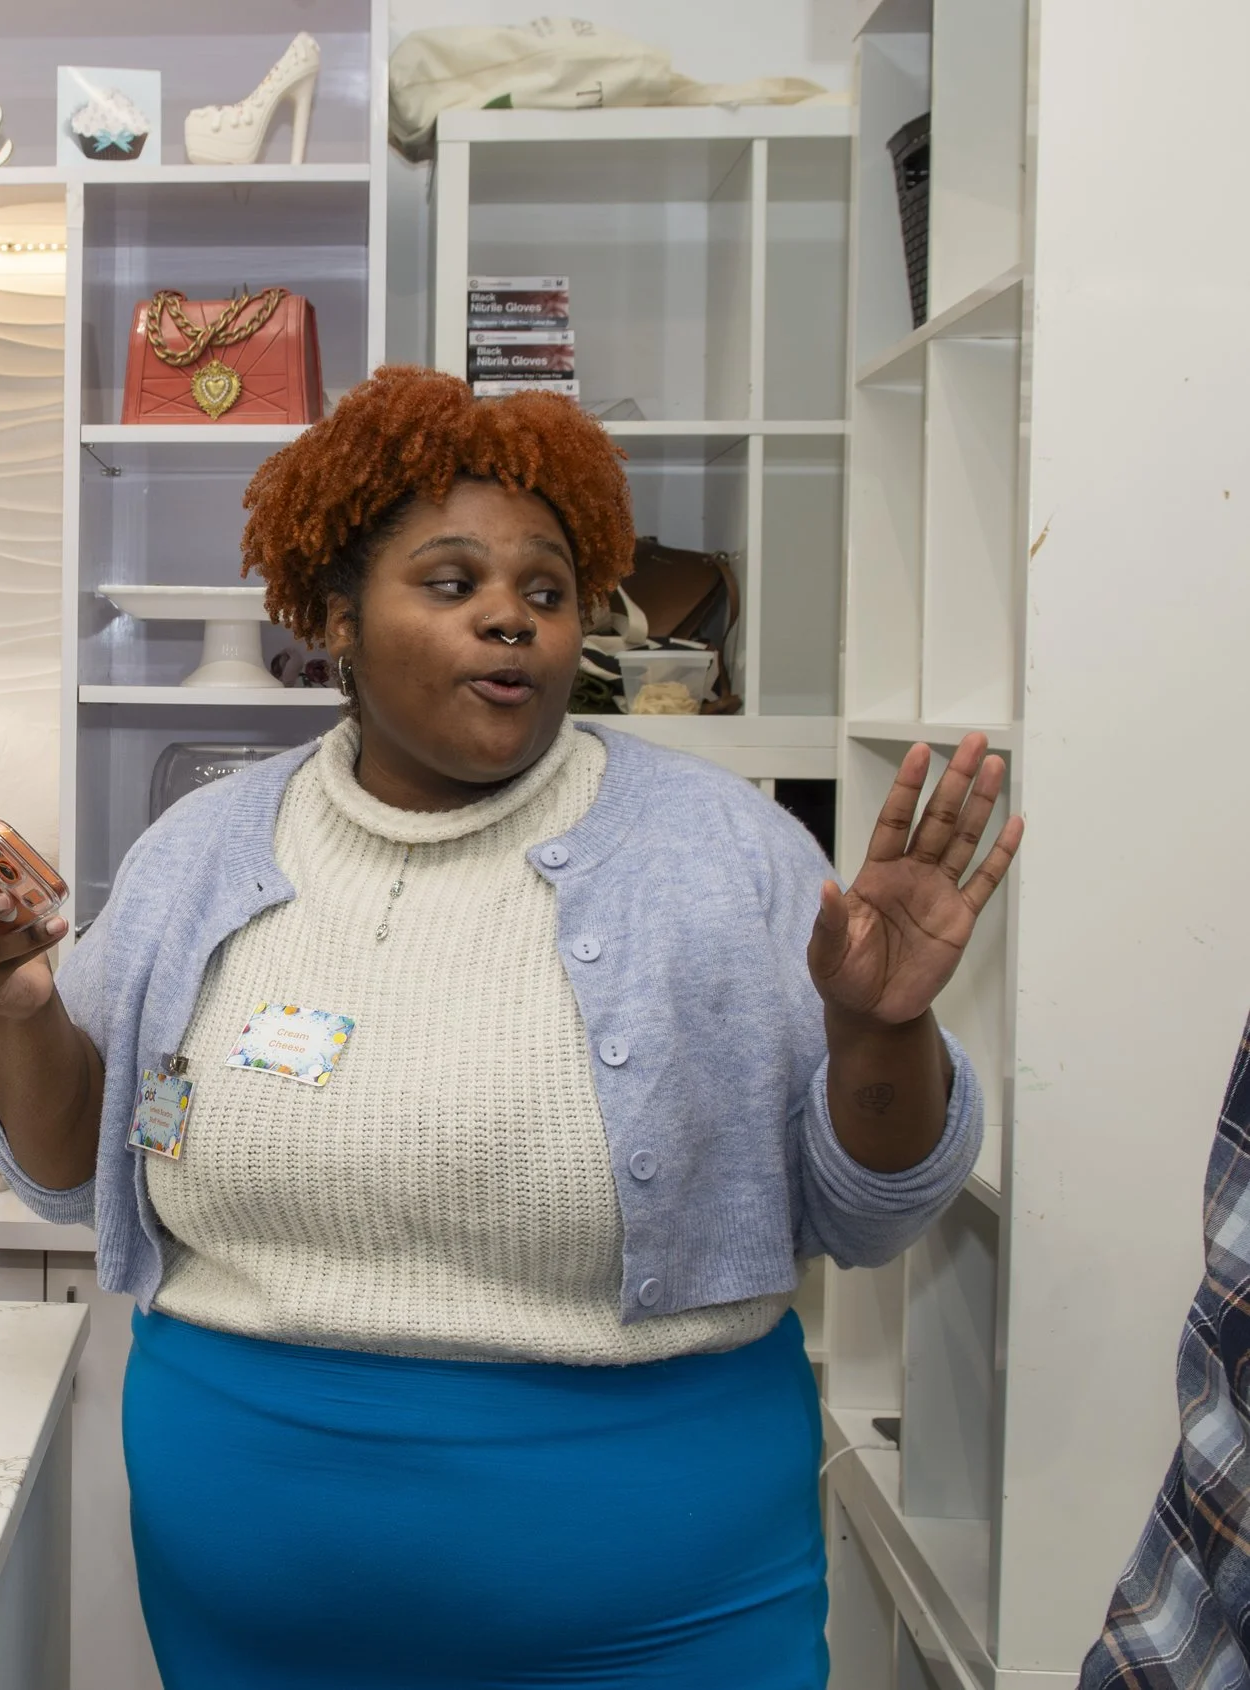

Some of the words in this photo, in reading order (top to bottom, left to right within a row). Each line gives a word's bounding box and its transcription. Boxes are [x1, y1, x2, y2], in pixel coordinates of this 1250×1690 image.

[470, 293, 496, 302] Black
[470, 303, 503, 312] Nitrile
[505, 302, 543, 312] Gloves
[476, 346, 502, 355] Black
[476, 356, 509, 366] Nitrile
[511, 356, 548, 366] Gloves
[276, 1028, 310, 1042] Cream
[268, 1039, 306, 1054] Cheese
